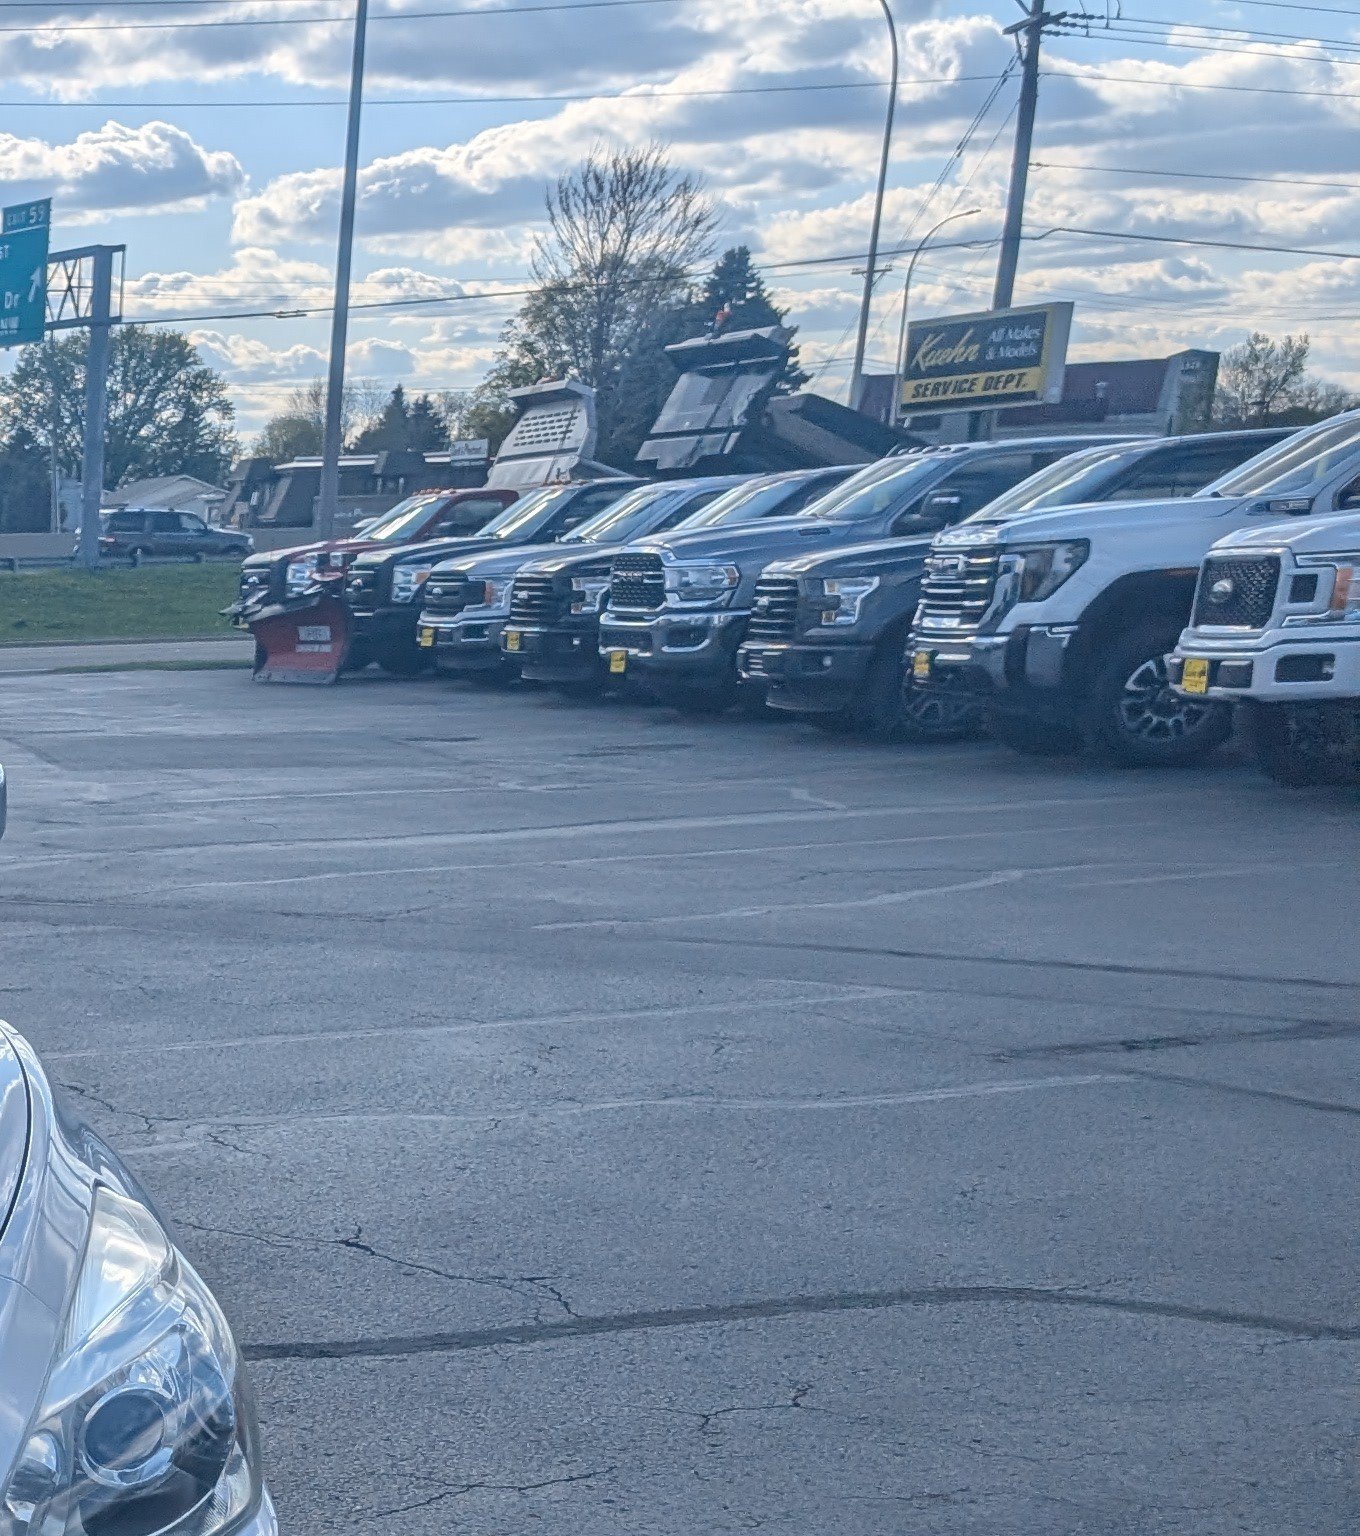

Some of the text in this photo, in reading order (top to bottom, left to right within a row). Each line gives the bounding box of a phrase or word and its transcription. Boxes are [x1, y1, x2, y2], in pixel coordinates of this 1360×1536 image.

[29, 204, 46, 224] 59
[4, 291, 21, 310] Dr
[0, 316, 21, 336] NW
[988, 327, 1006, 343] All
[910, 327, 980, 372] Kuehn
[912, 371, 1028, 399] SERVICE DEPT.
